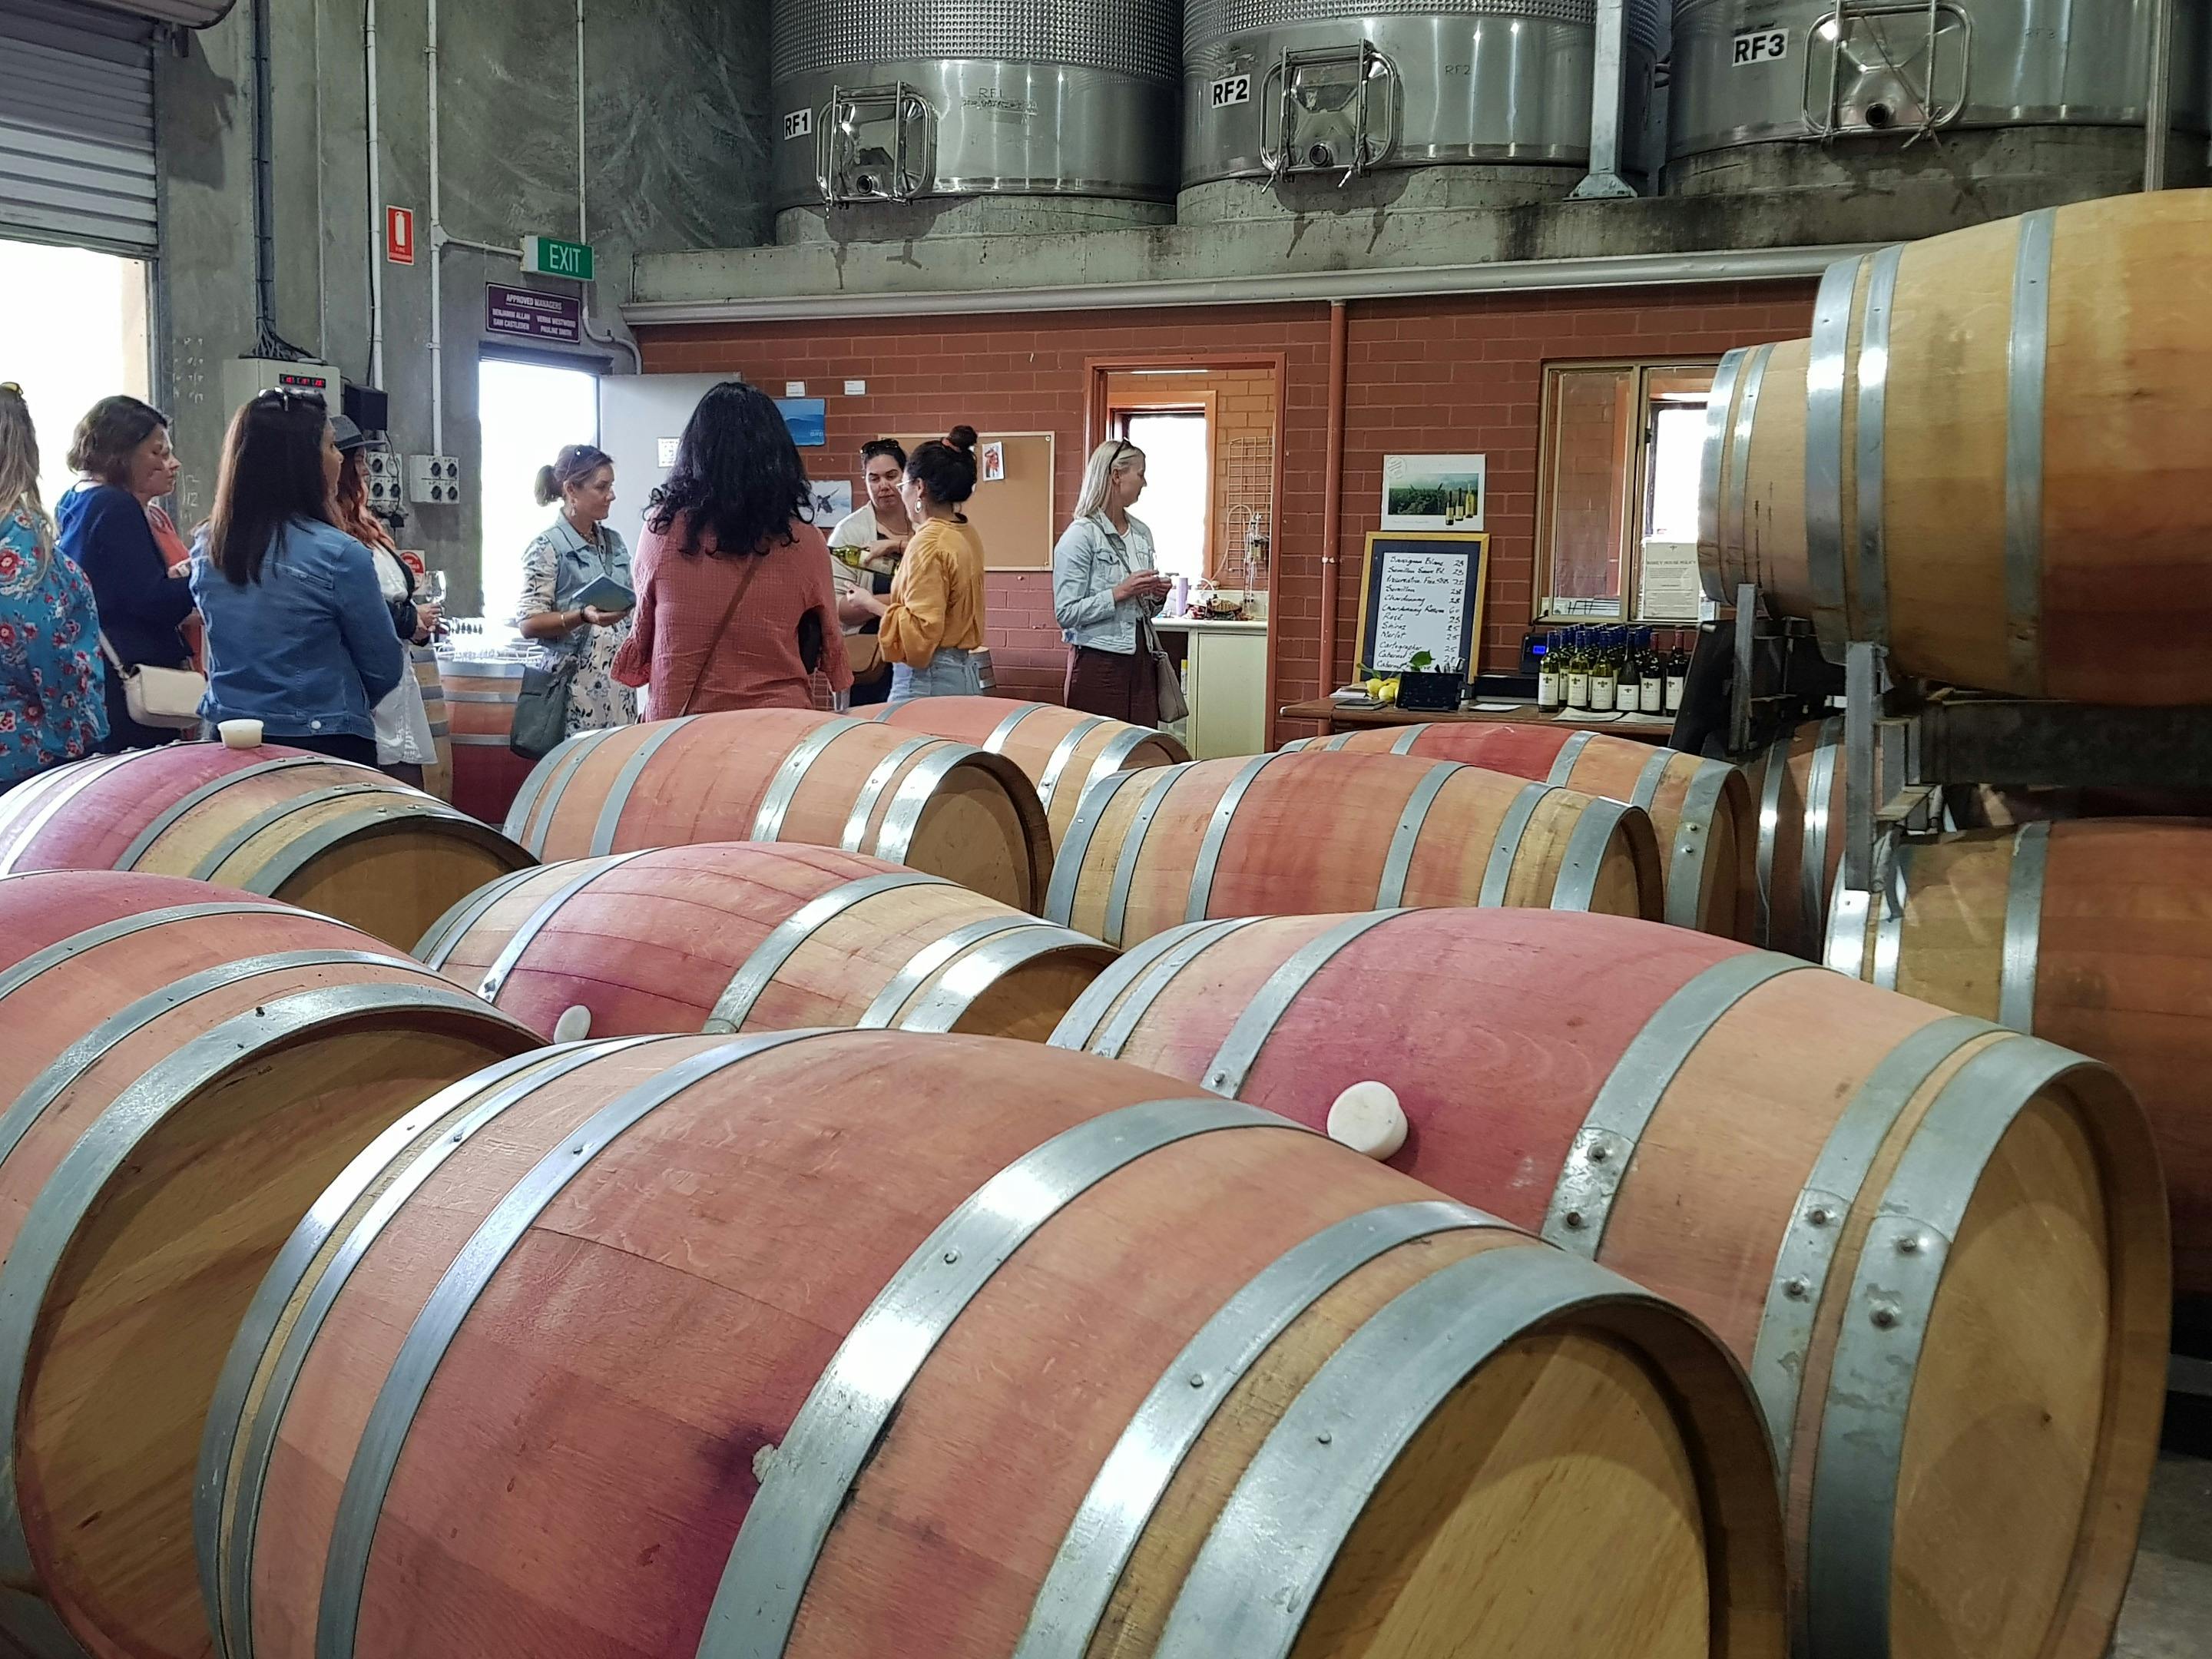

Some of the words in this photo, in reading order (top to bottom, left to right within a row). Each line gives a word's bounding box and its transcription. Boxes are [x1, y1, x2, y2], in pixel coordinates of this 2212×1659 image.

[1735, 33, 1785, 63] RF3
[1214, 78, 1248, 105] RF2
[785, 112, 808, 137] RF1
[549, 243, 581, 273] EXIT
[506, 293, 534, 306] APPROVED
[1380, 631, 1406, 639] Merlot
